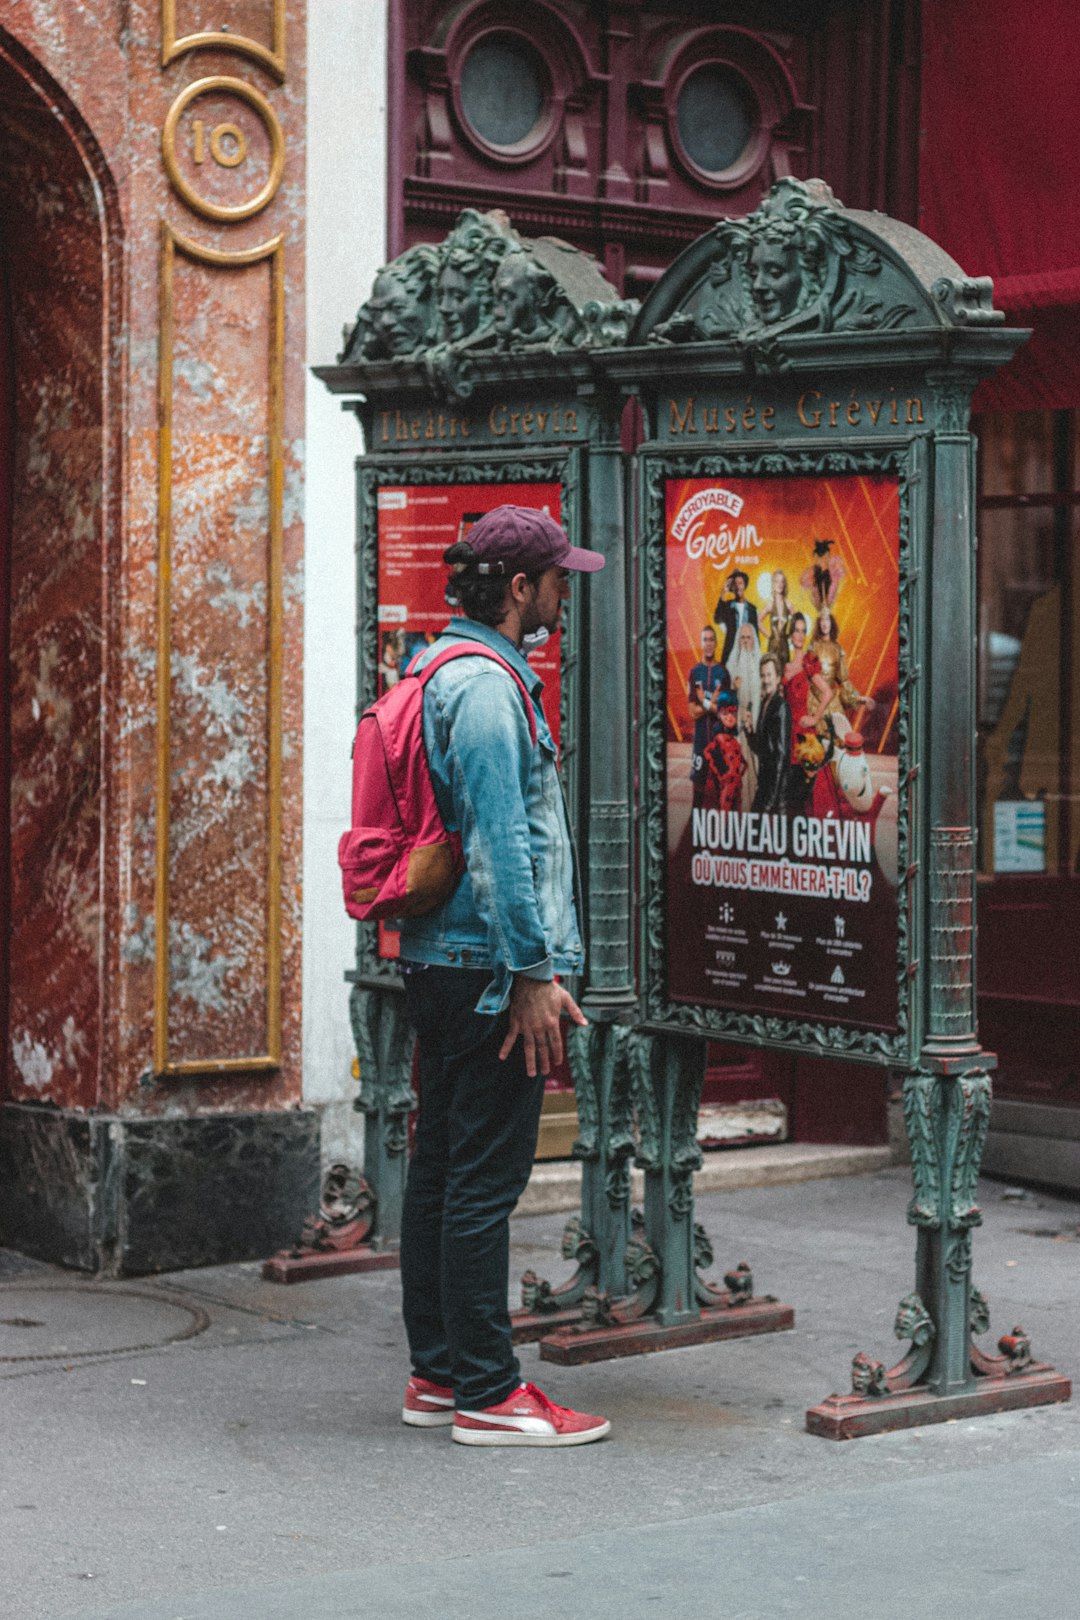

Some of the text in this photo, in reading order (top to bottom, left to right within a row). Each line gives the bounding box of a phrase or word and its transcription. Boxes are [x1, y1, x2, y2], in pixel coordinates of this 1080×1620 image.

[192, 120, 246, 167] 10
[489, 402, 579, 436] Grévin
[668, 387, 925, 433] Musée Grévin
[673, 491, 741, 537] INCROYABLE
[692, 807, 871, 863] NOUVEAU GRÉVIN
[694, 855, 711, 881] OÙ
[714, 860, 747, 885] VOUS
